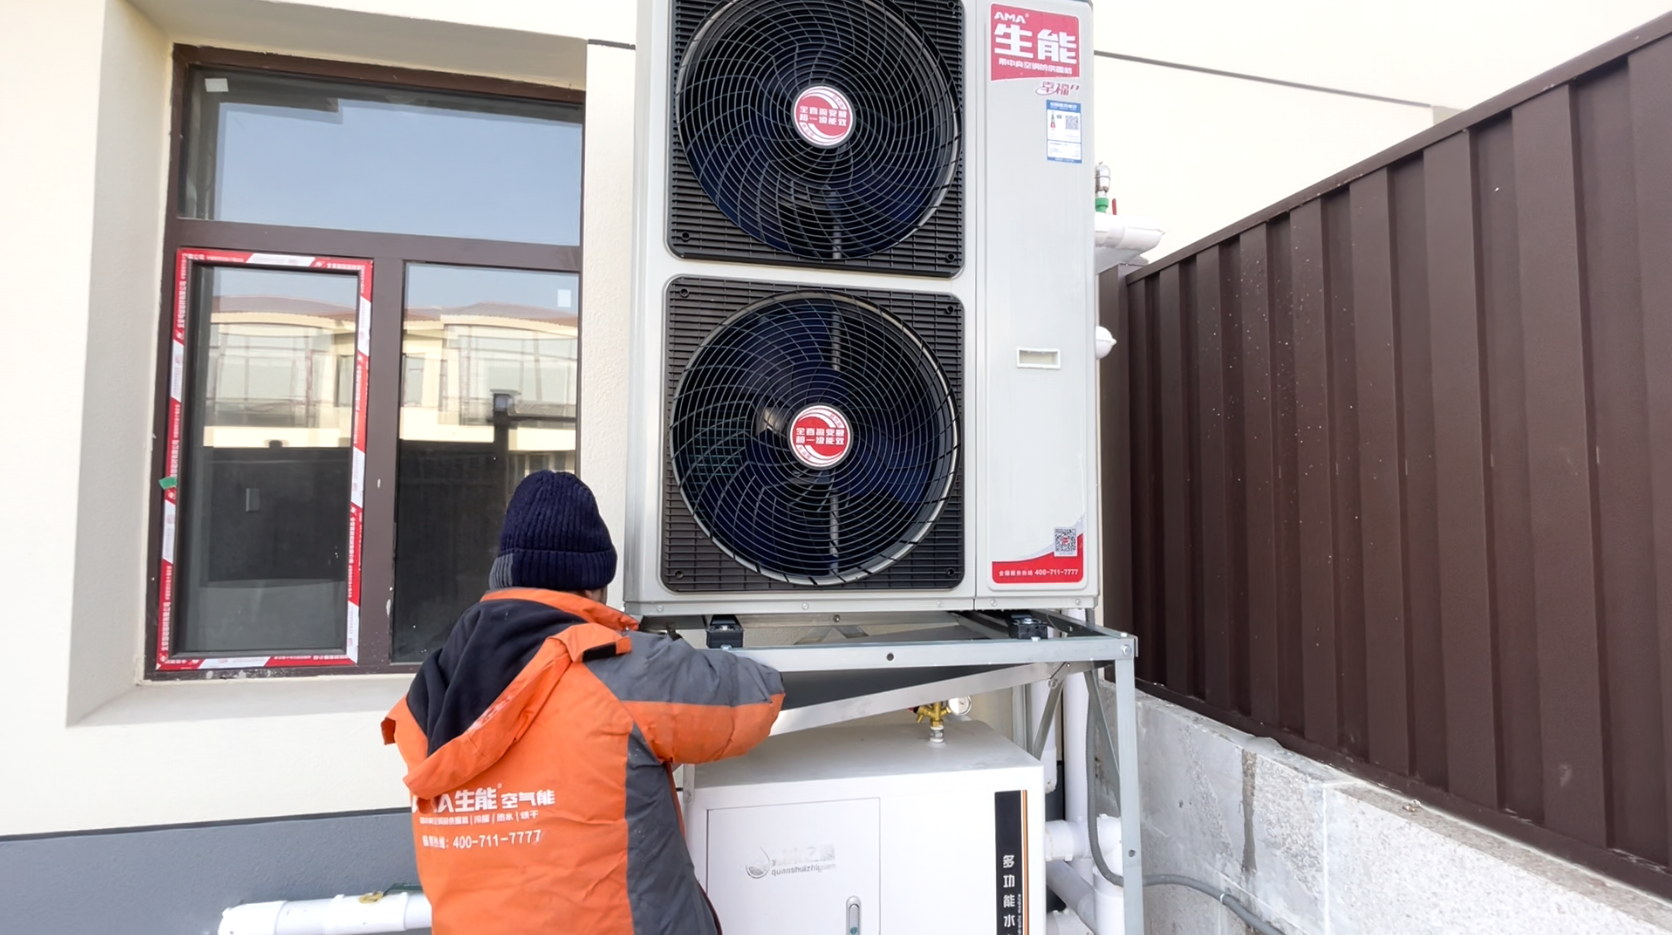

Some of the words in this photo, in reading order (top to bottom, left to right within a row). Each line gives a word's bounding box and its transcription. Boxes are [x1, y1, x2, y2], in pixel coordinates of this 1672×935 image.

[994, 11, 1026, 24] AMA
[994, 23, 1077, 64] 生能
[1034, 568, 1079, 576] 400-711-7777
[500, 789, 556, 809] 空气能
[452, 829, 542, 849] 400-711-7777
[1002, 854, 1016, 935] 多功能水
